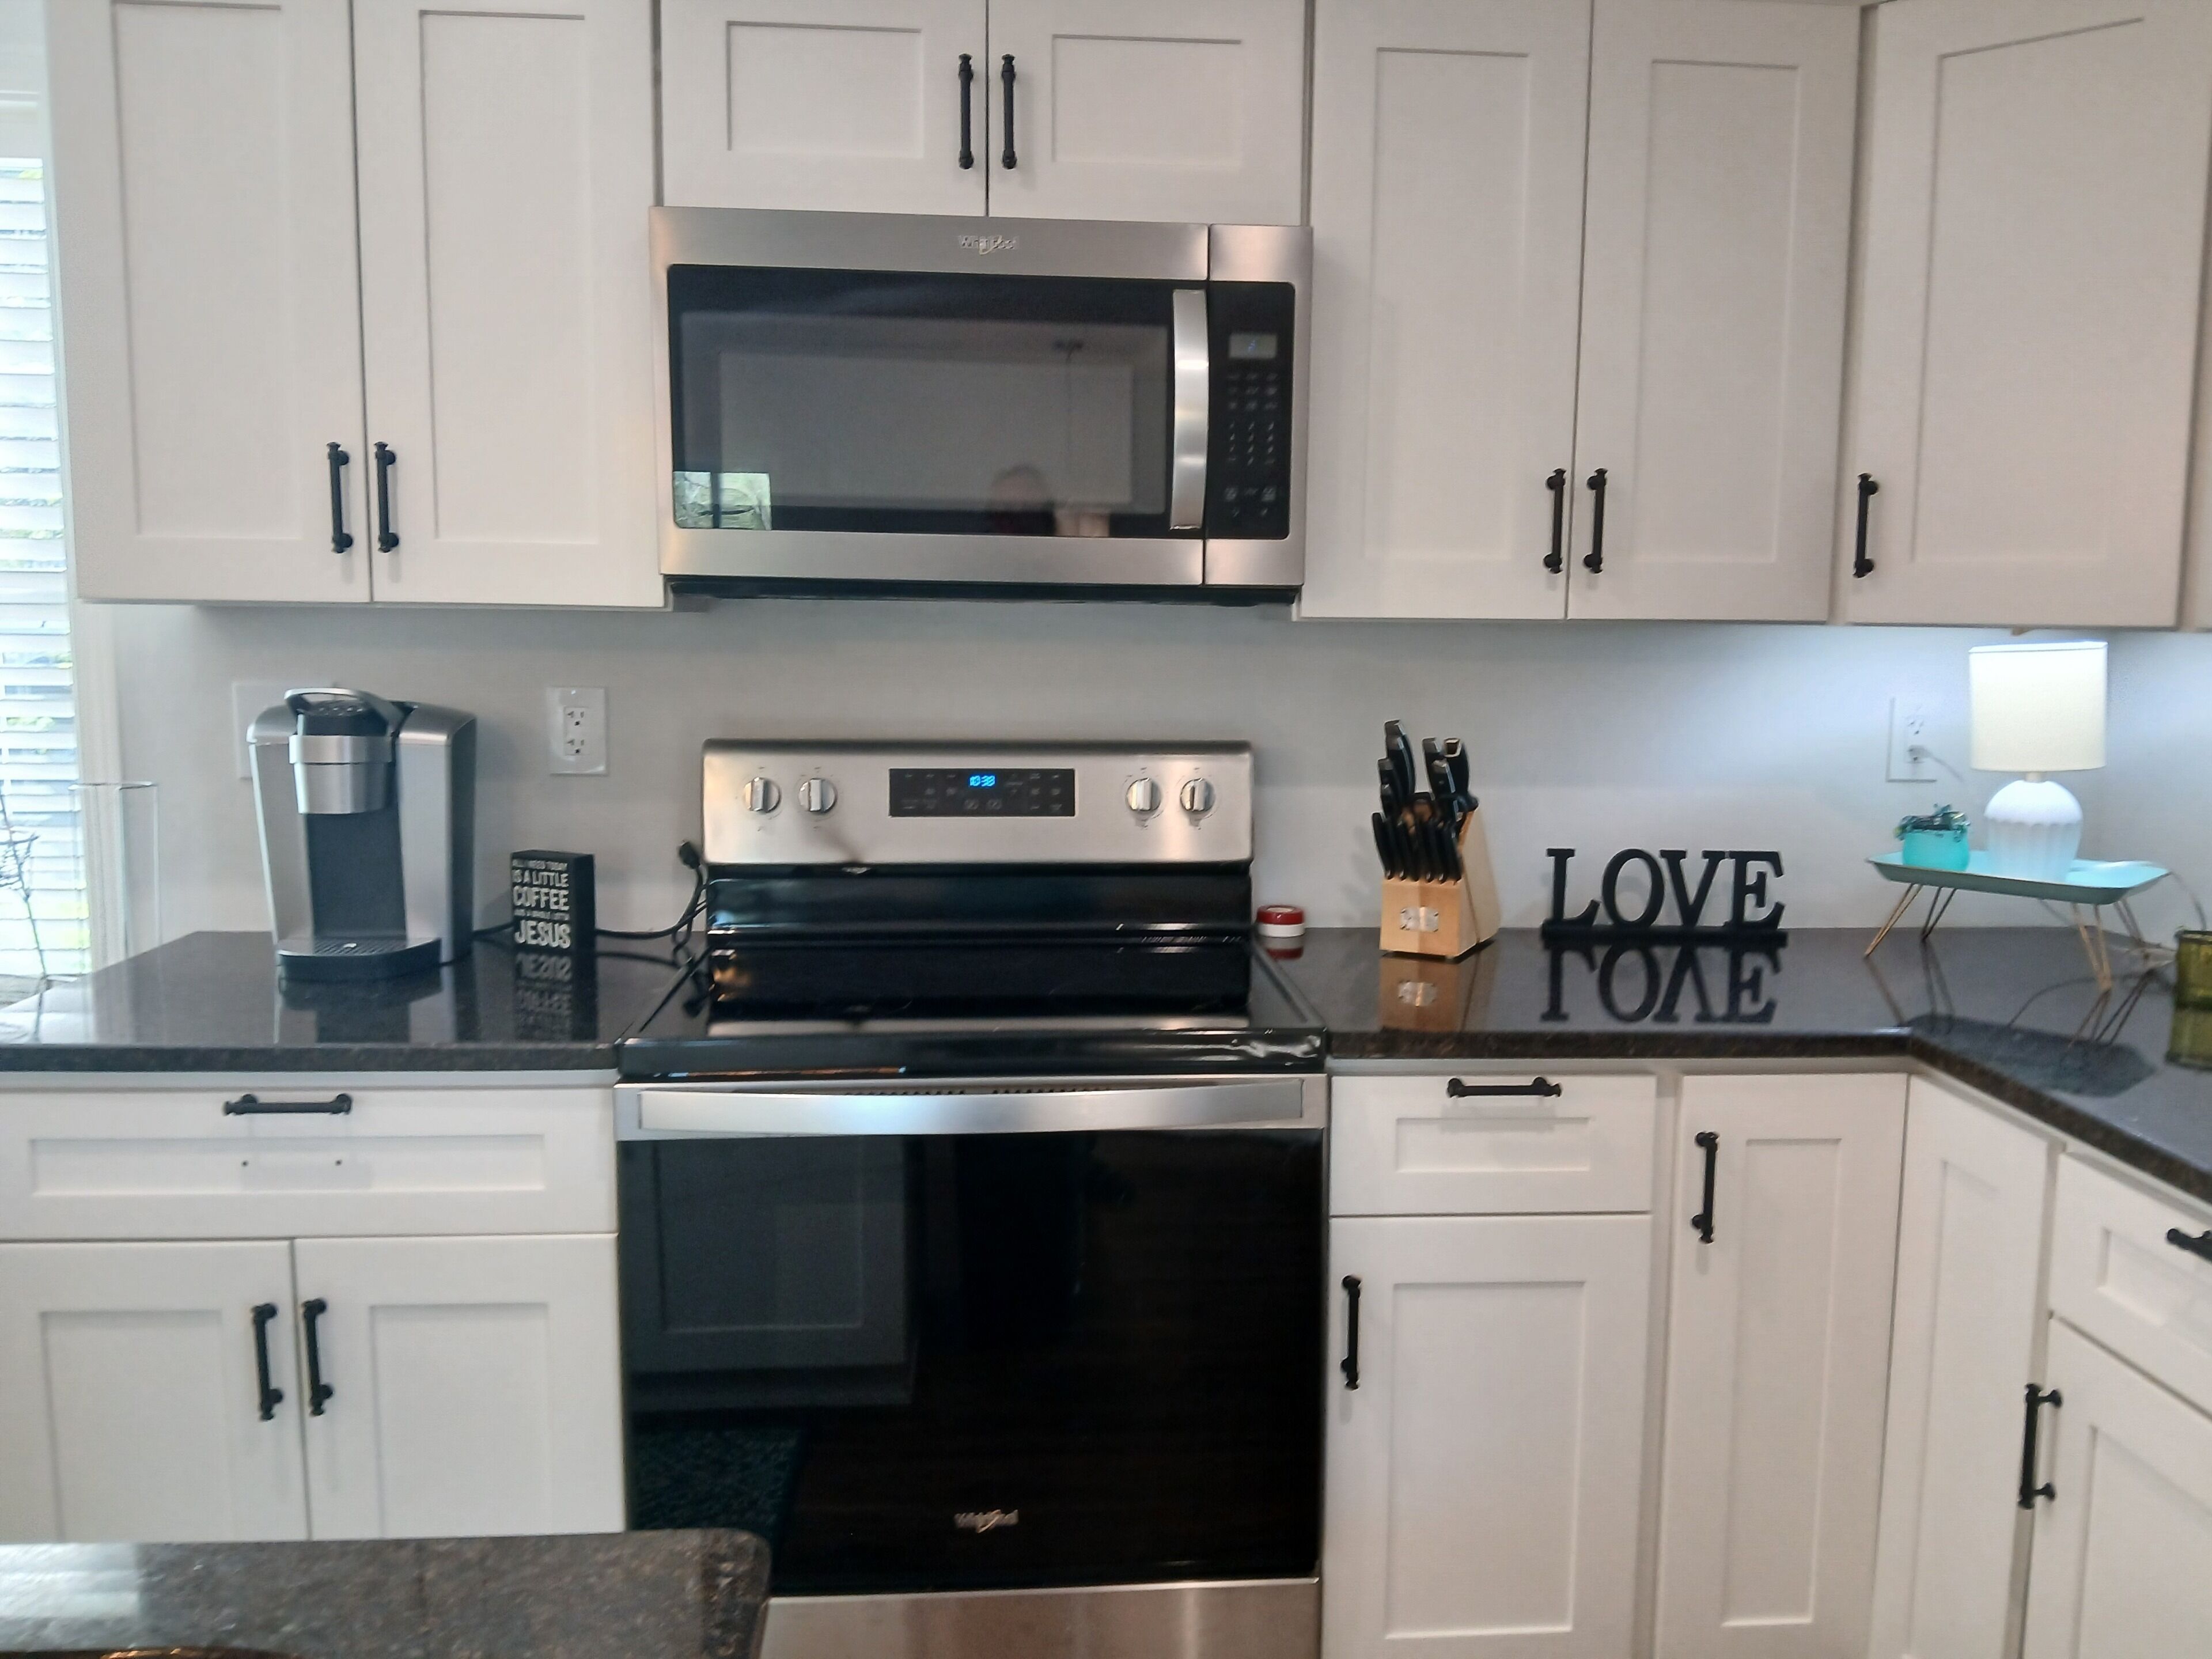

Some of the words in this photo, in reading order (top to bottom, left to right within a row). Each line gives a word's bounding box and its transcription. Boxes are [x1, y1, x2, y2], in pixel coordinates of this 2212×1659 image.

[532, 871, 569, 888] LITTLE
[1544, 848, 1785, 930] LOVE
[513, 885, 570, 911] COFFEE
[514, 920, 571, 949] JESUS
